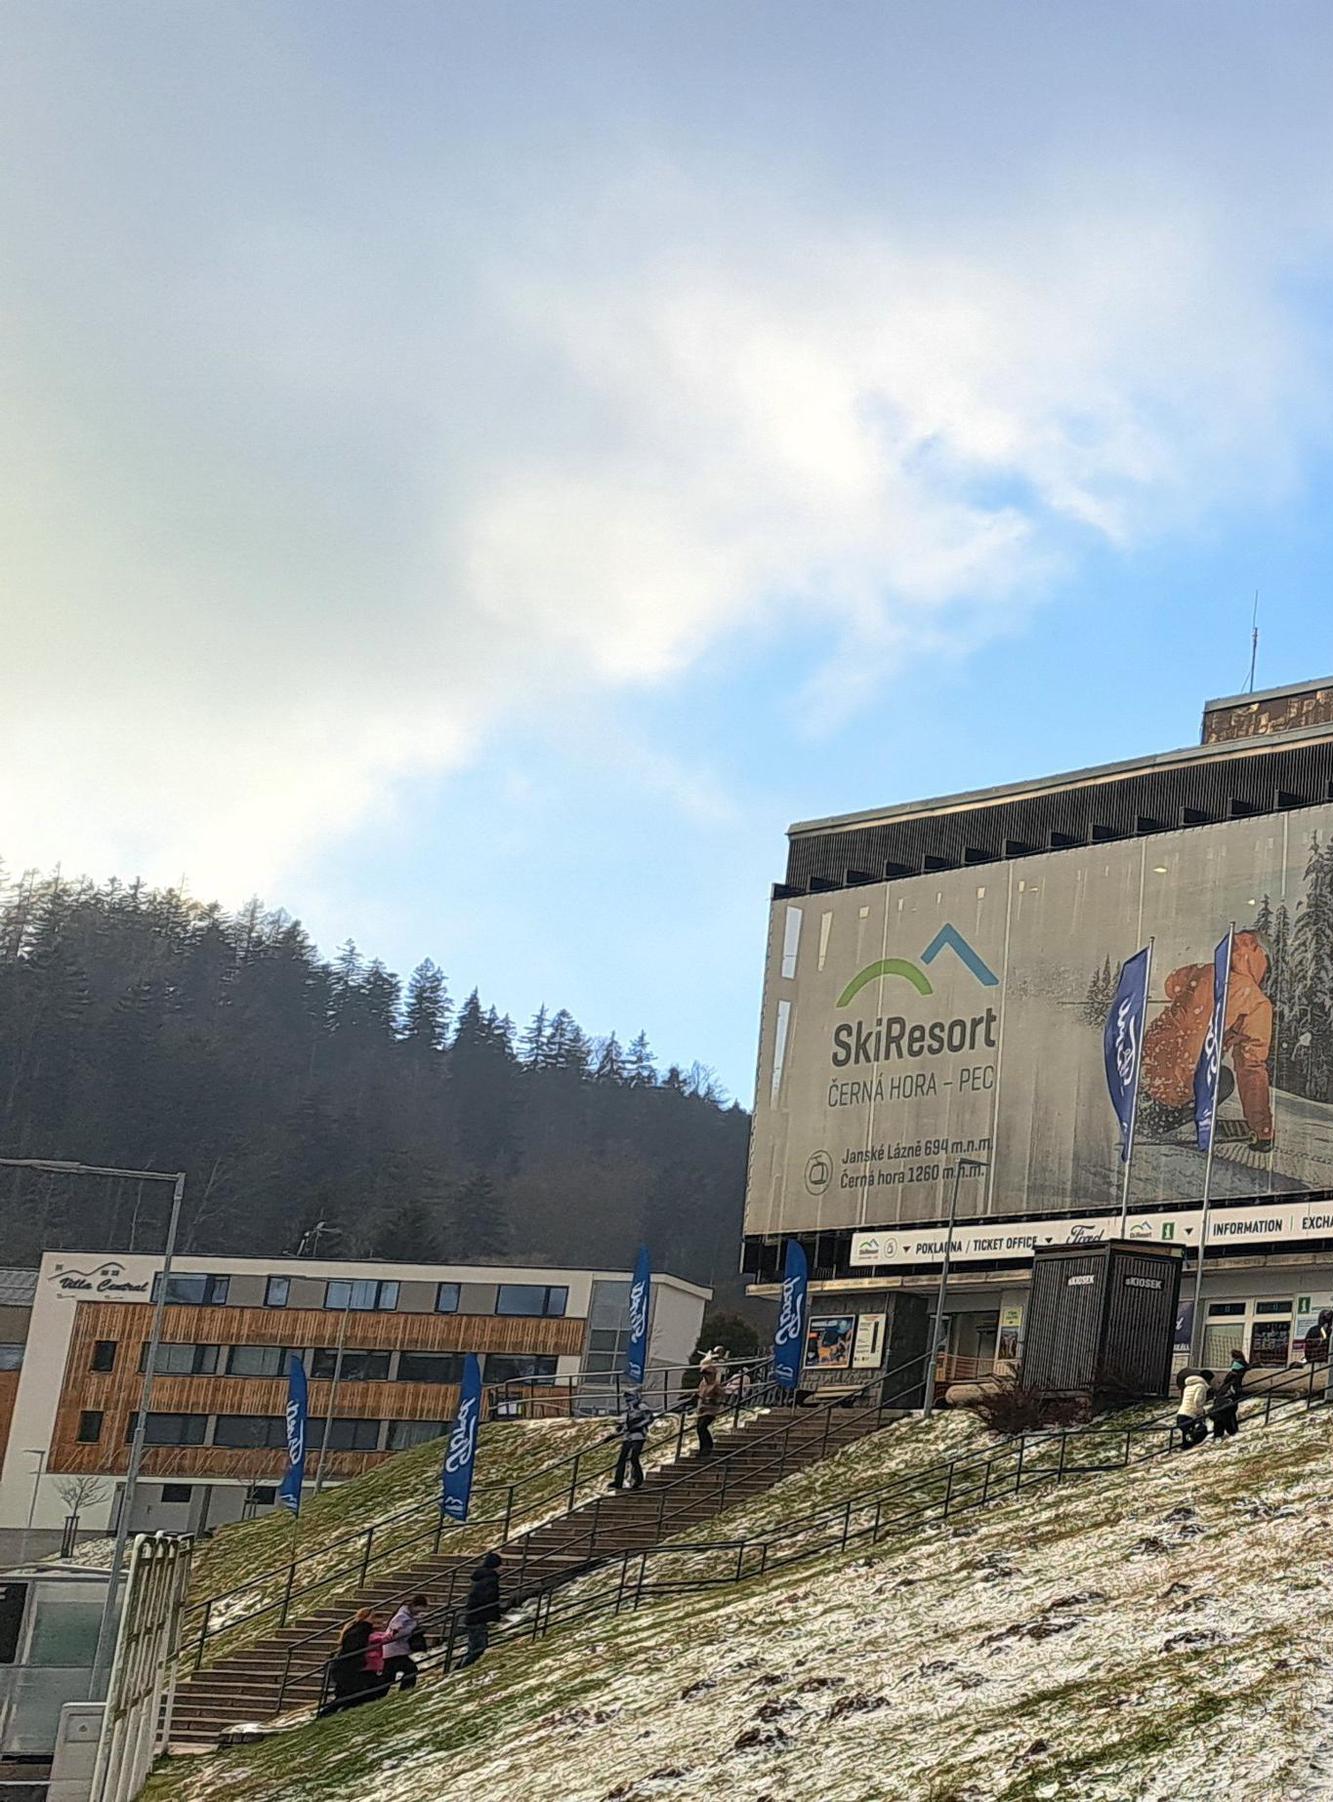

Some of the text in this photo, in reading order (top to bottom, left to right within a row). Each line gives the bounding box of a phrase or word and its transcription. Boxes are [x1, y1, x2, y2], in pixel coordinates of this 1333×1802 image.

[831, 1007, 997, 1067] SkiResort
[828, 1072, 884, 1108] ČERNÁ
[890, 1071, 937, 1101] HORA
[959, 1065, 995, 1093] PEC
[842, 1145, 885, 1165] Janské
[887, 1141, 922, 1160] Lázně
[924, 1138, 949, 1156] 694
[840, 1164, 874, 1189] Černá
[877, 1167, 905, 1186] hora
[908, 1164, 940, 1183] 1260
[1066, 1224, 1105, 1244] Ford
[1212, 1218, 1283, 1237] INFORMATION
[973, 1238, 1004, 1251] TICKET
[1006, 1235, 1037, 1250] OFFICE
[59, 1277, 149, 1293] Villa Central
